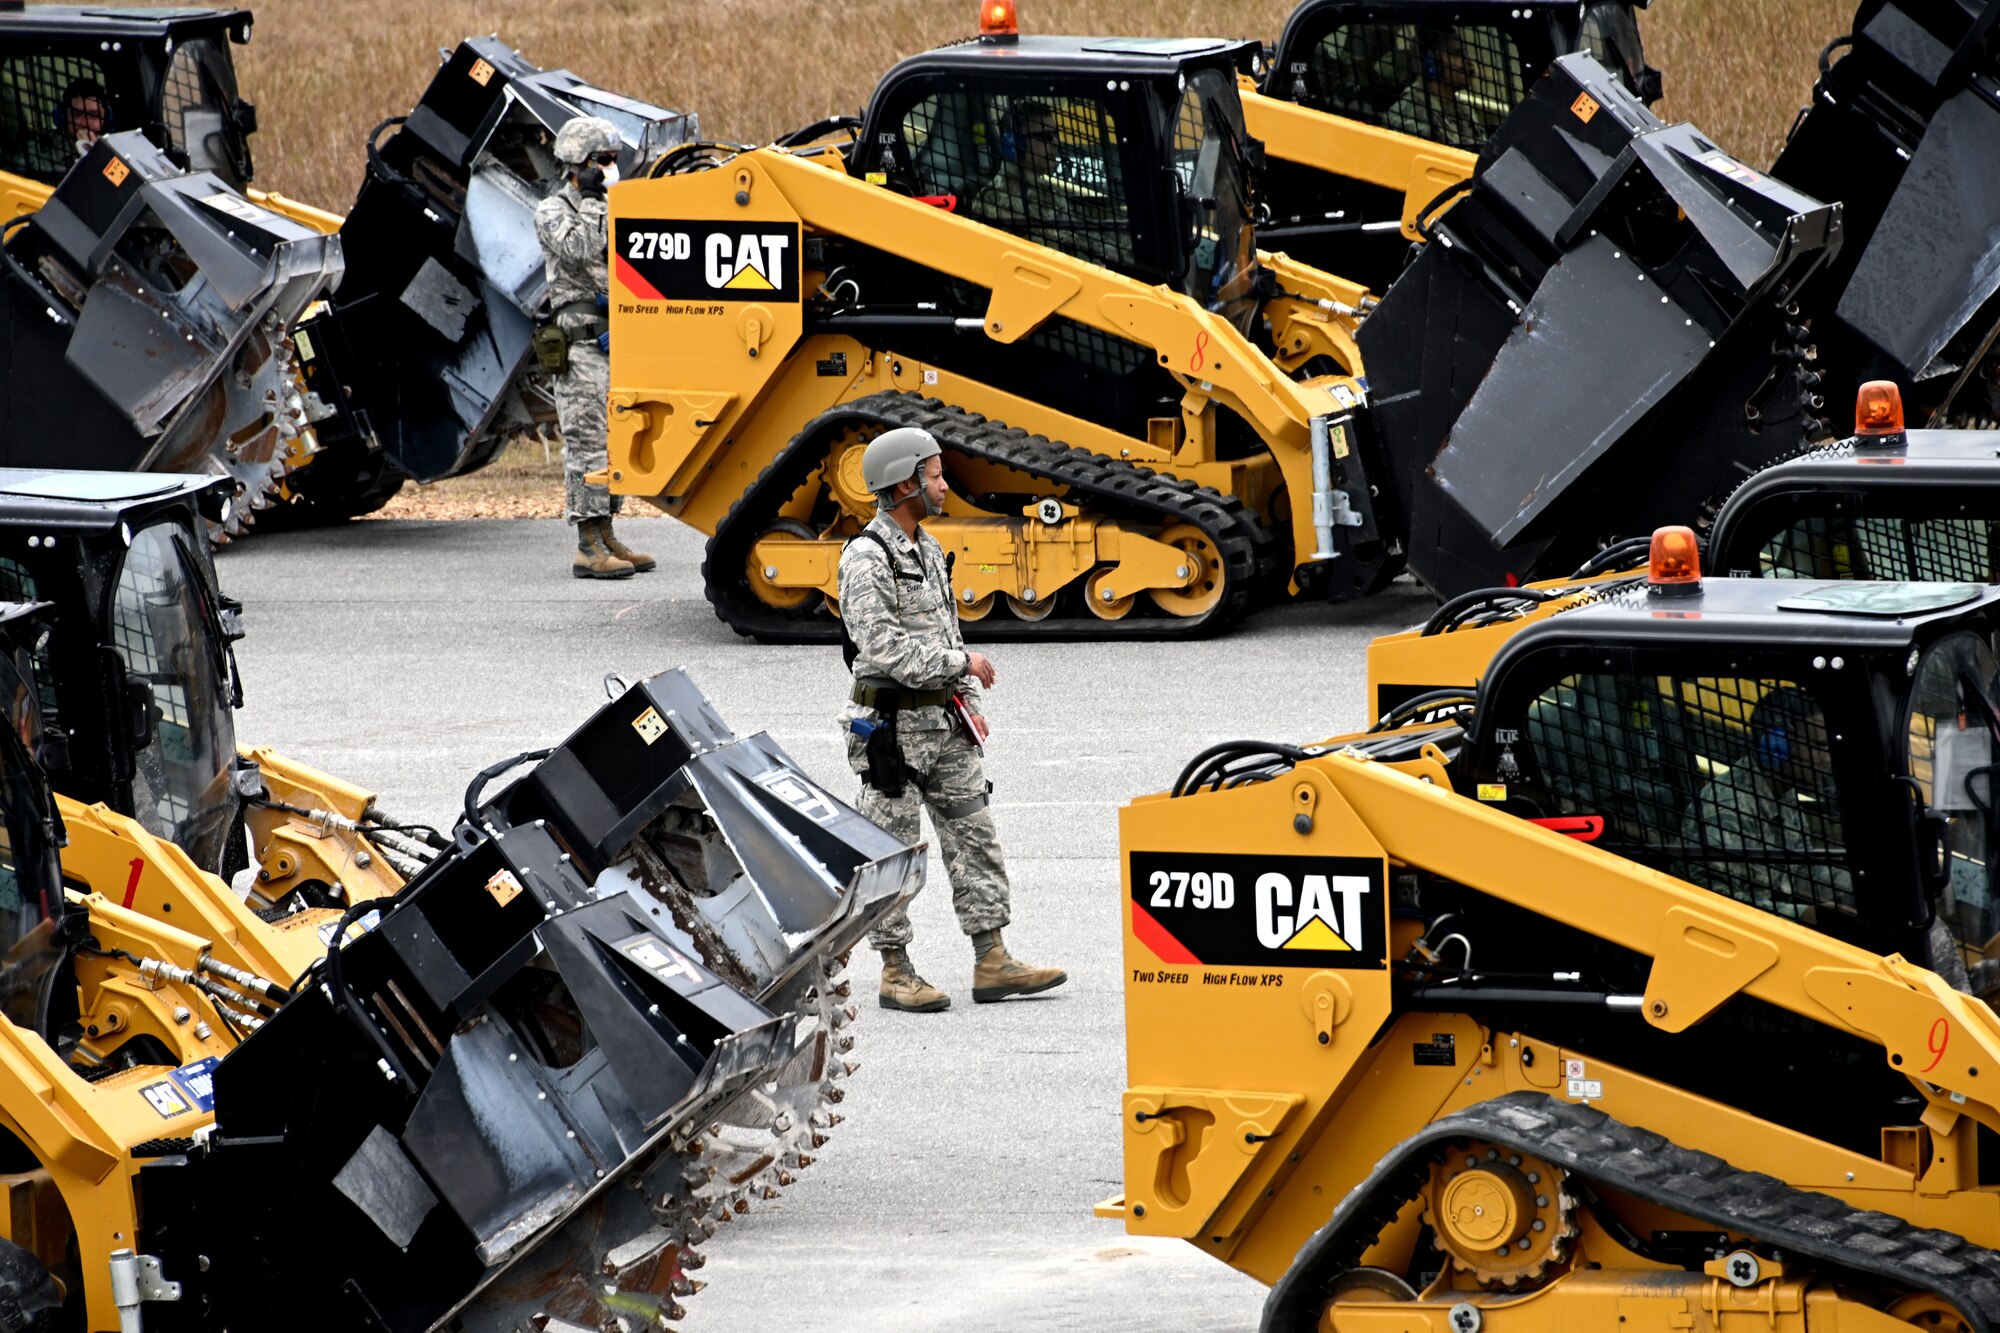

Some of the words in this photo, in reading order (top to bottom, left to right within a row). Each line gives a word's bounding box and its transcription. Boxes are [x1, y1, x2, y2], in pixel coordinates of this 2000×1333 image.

[628, 231, 691, 260] 279D
[705, 232, 789, 290] CAT
[707, 306, 724, 316] XPS
[1190, 330, 1209, 373] 8
[121, 857, 145, 910] 1
[1149, 870, 1235, 909] 279D
[1255, 872, 1370, 951] CAT
[1260, 974, 1284, 987] XPS
[1920, 1017, 1949, 1073] 9
[144, 1083, 187, 1116] CAT
